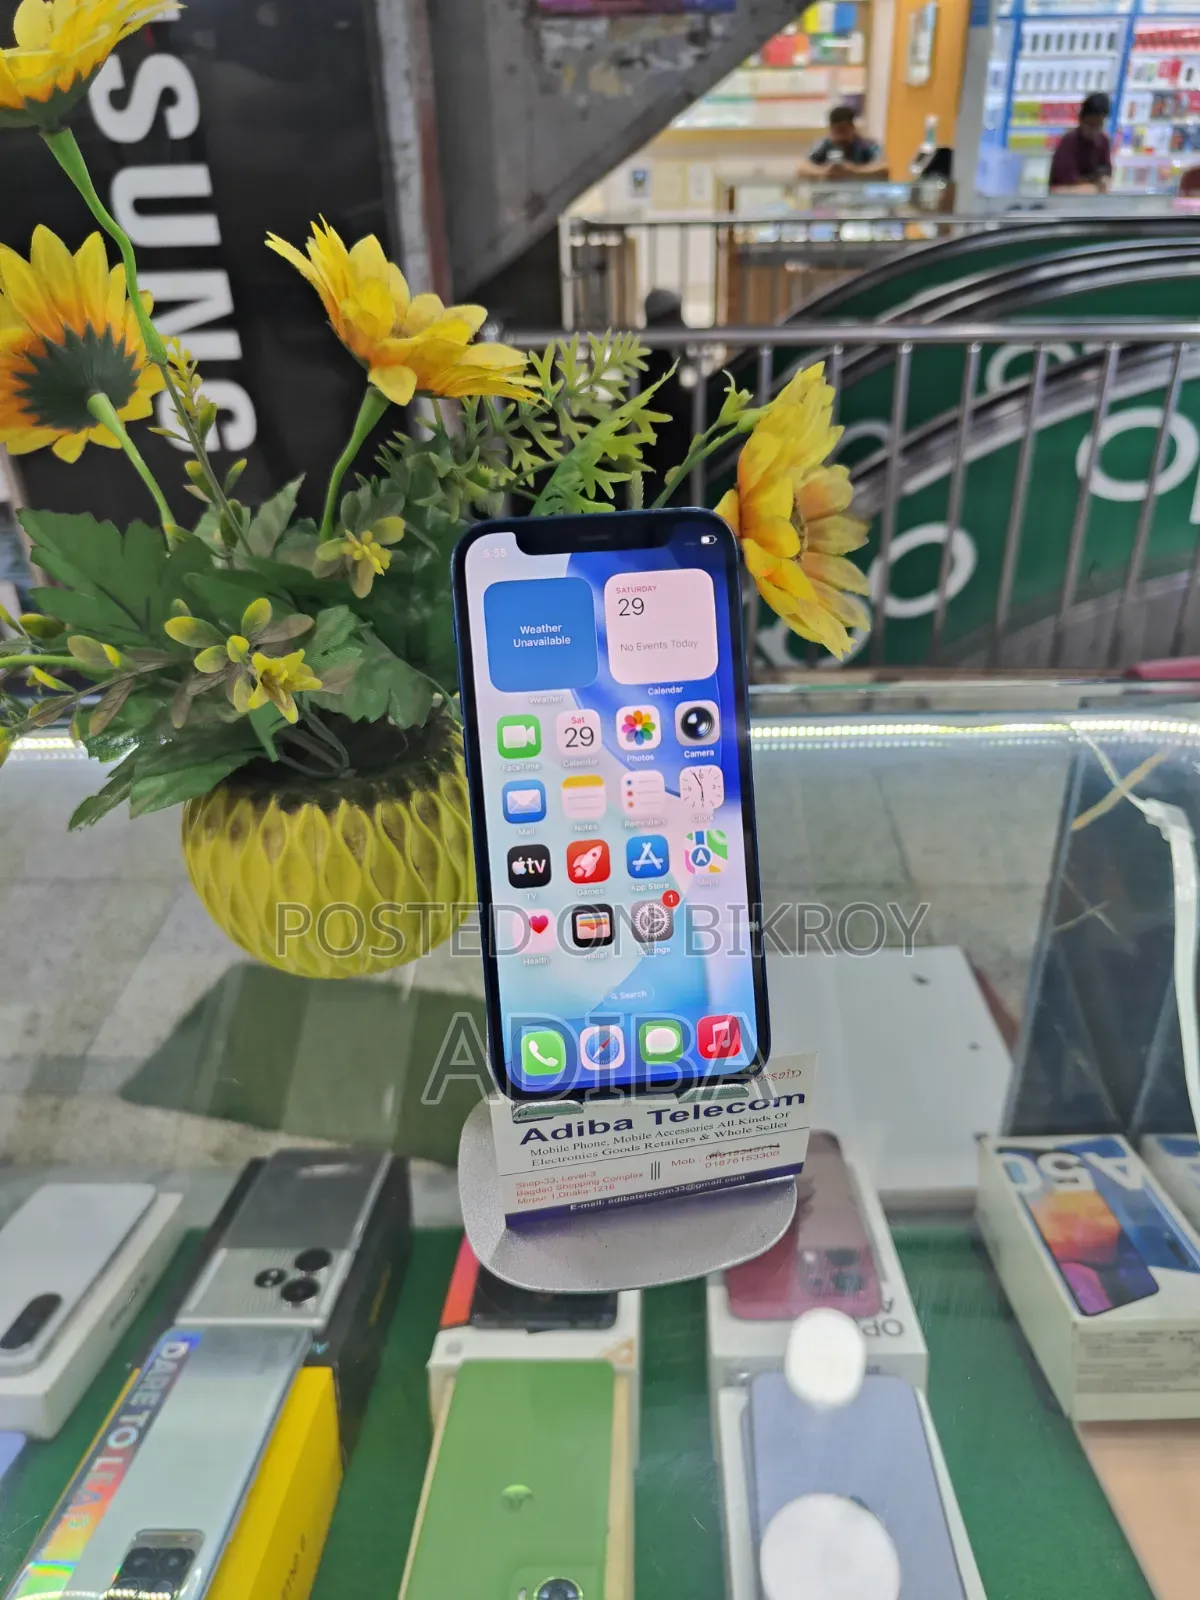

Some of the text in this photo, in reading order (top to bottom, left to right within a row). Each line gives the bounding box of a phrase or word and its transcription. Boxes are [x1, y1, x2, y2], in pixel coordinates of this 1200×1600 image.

[88, 0, 257, 453] SUNG
[483, 549, 507, 558] 5:55
[616, 584, 657, 594] SATURDAY
[618, 597, 645, 617] 29
[520, 623, 562, 635] Weather
[513, 635, 571, 648] Unavailable
[620, 639, 699, 652] No Events Today
[647, 685, 684, 696] Calendar
[528, 695, 564, 705] Weather
[571, 716, 586, 724] Sat
[564, 726, 595, 749] 29
[626, 753, 655, 763] Photos
[683, 749, 715, 759] Camera
[502, 762, 540, 772] FaceTime
[563, 757, 599, 767] Calendar
[574, 823, 598, 832] Notes
[624, 817, 667, 828] Reminders
[518, 826, 535, 836] Mail
[526, 858, 547, 875] tv
[576, 886, 605, 896] Games
[630, 880, 670, 893] App Store
[668, 894, 674, 903] 1
[638, 945, 671, 956] Settings
[523, 956, 550, 966] Health
[619, 988, 647, 998] Search
[754, 1068, 803, 1083] ossain
[520, 1092, 806, 1146] Adiba Telecom
[530, 1145, 570, 1157] Mobile
[573, 1140, 610, 1151] Phone,
[613, 1133, 652, 1145] Mobile
[655, 1124, 714, 1138] Accessories
[774, 1111, 791, 1119] Of
[531, 1121, 789, 1167] Electronics Goods Retailers & Whole Seller
[561, 1171, 597, 1182] Level-3
[516, 1171, 644, 1198] Bagdad Shopping Complex
[570, 1174, 746, 1211] E-mail: adibatelecom33@gmail.com
[517, 1195, 547, 1205] Mirpur
[129, 1340, 191, 1407] DARE
[106, 1410, 151, 1449] TO
